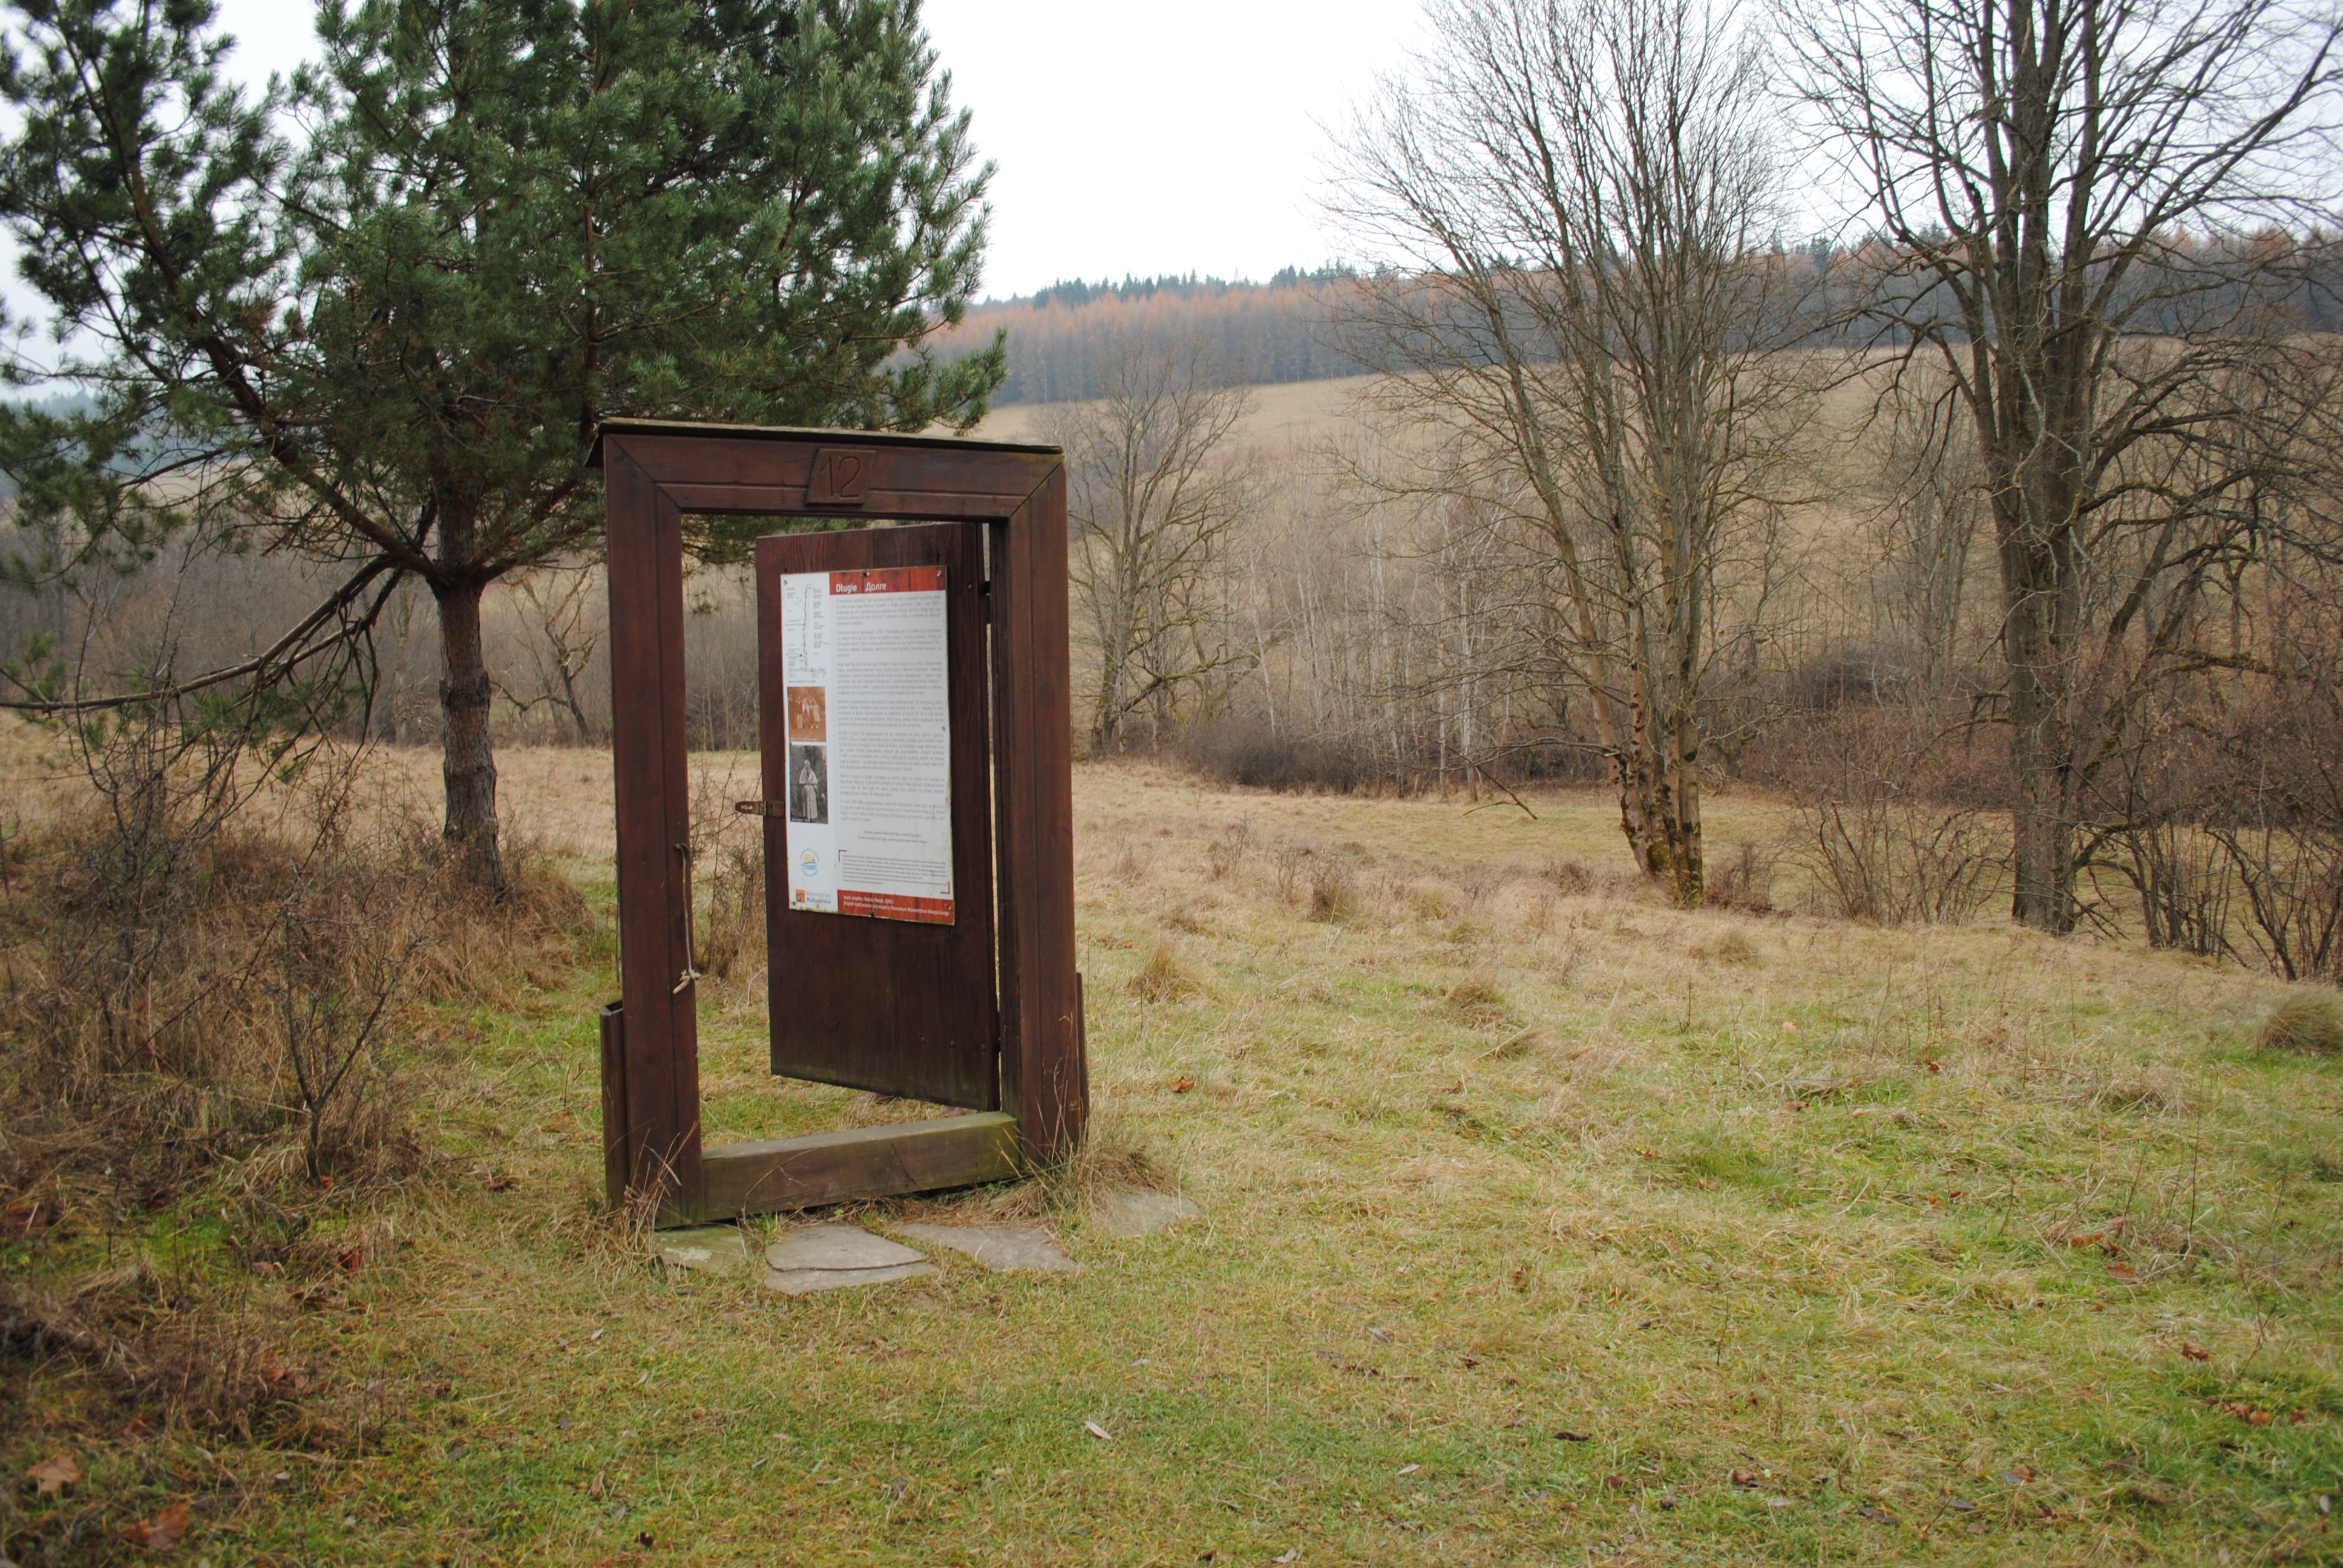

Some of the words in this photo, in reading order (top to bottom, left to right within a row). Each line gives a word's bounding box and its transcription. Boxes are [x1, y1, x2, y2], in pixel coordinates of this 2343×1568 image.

[819, 456, 860, 498] 12
[836, 583, 857, 594] Długie
[865, 582, 886, 592] Долге
